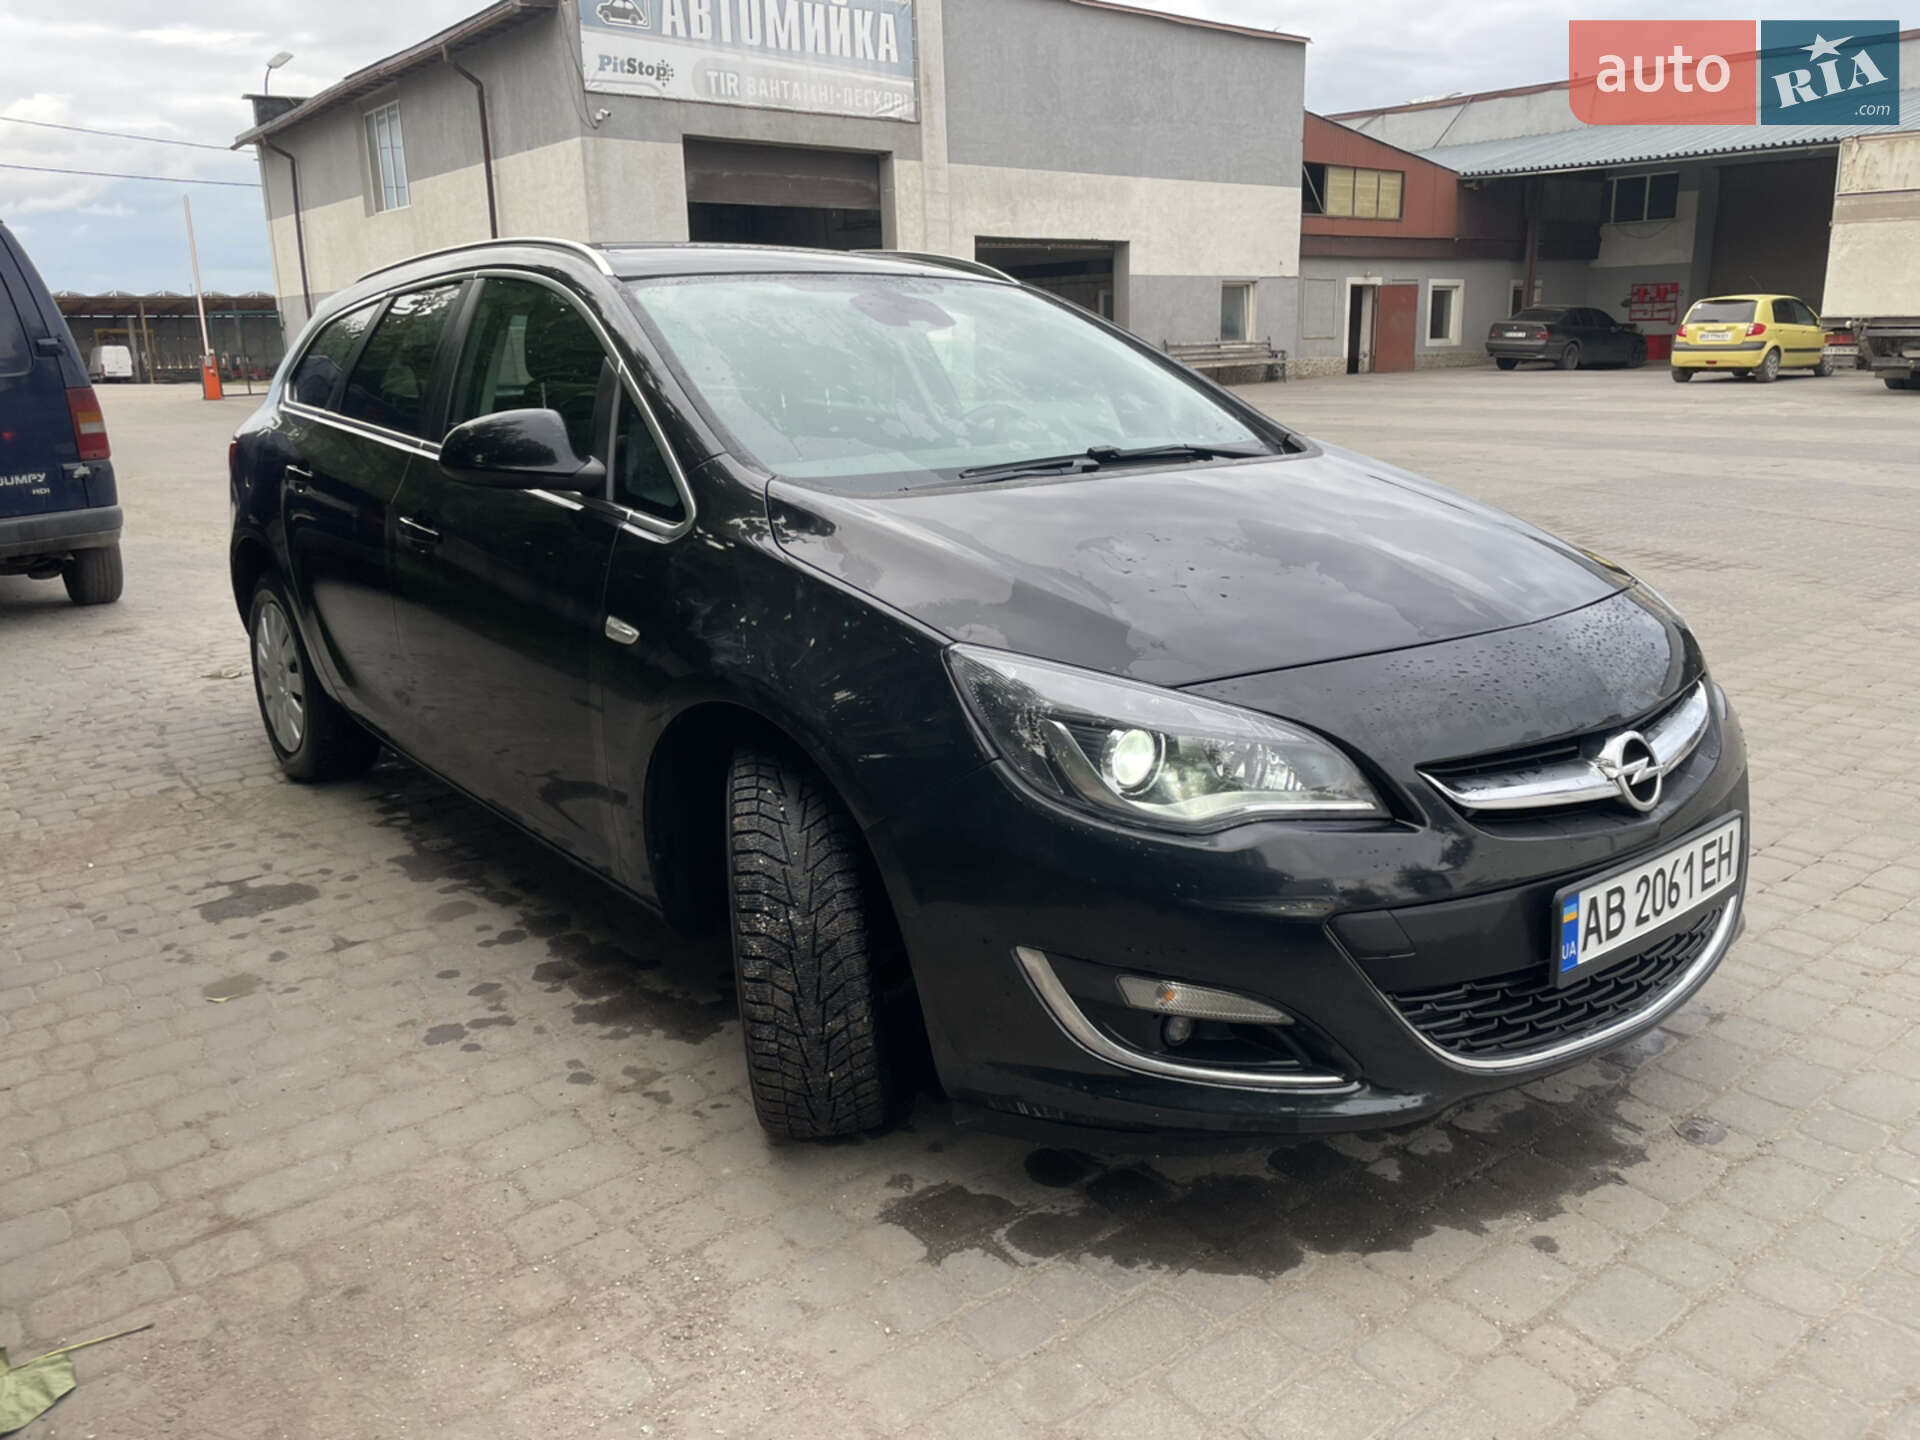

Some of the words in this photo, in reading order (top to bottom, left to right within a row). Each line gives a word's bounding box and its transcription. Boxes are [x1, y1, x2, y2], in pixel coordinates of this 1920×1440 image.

[662, 0, 899, 63] АВТОМИЙКА
[598, 54, 667, 81] PitStop
[706, 71, 739, 96] TIR
[1581, 885, 1626, 953] AB
[1635, 851, 1694, 927] 2061
[1701, 830, 1734, 892] EH
[1562, 941, 1577, 960] UA
